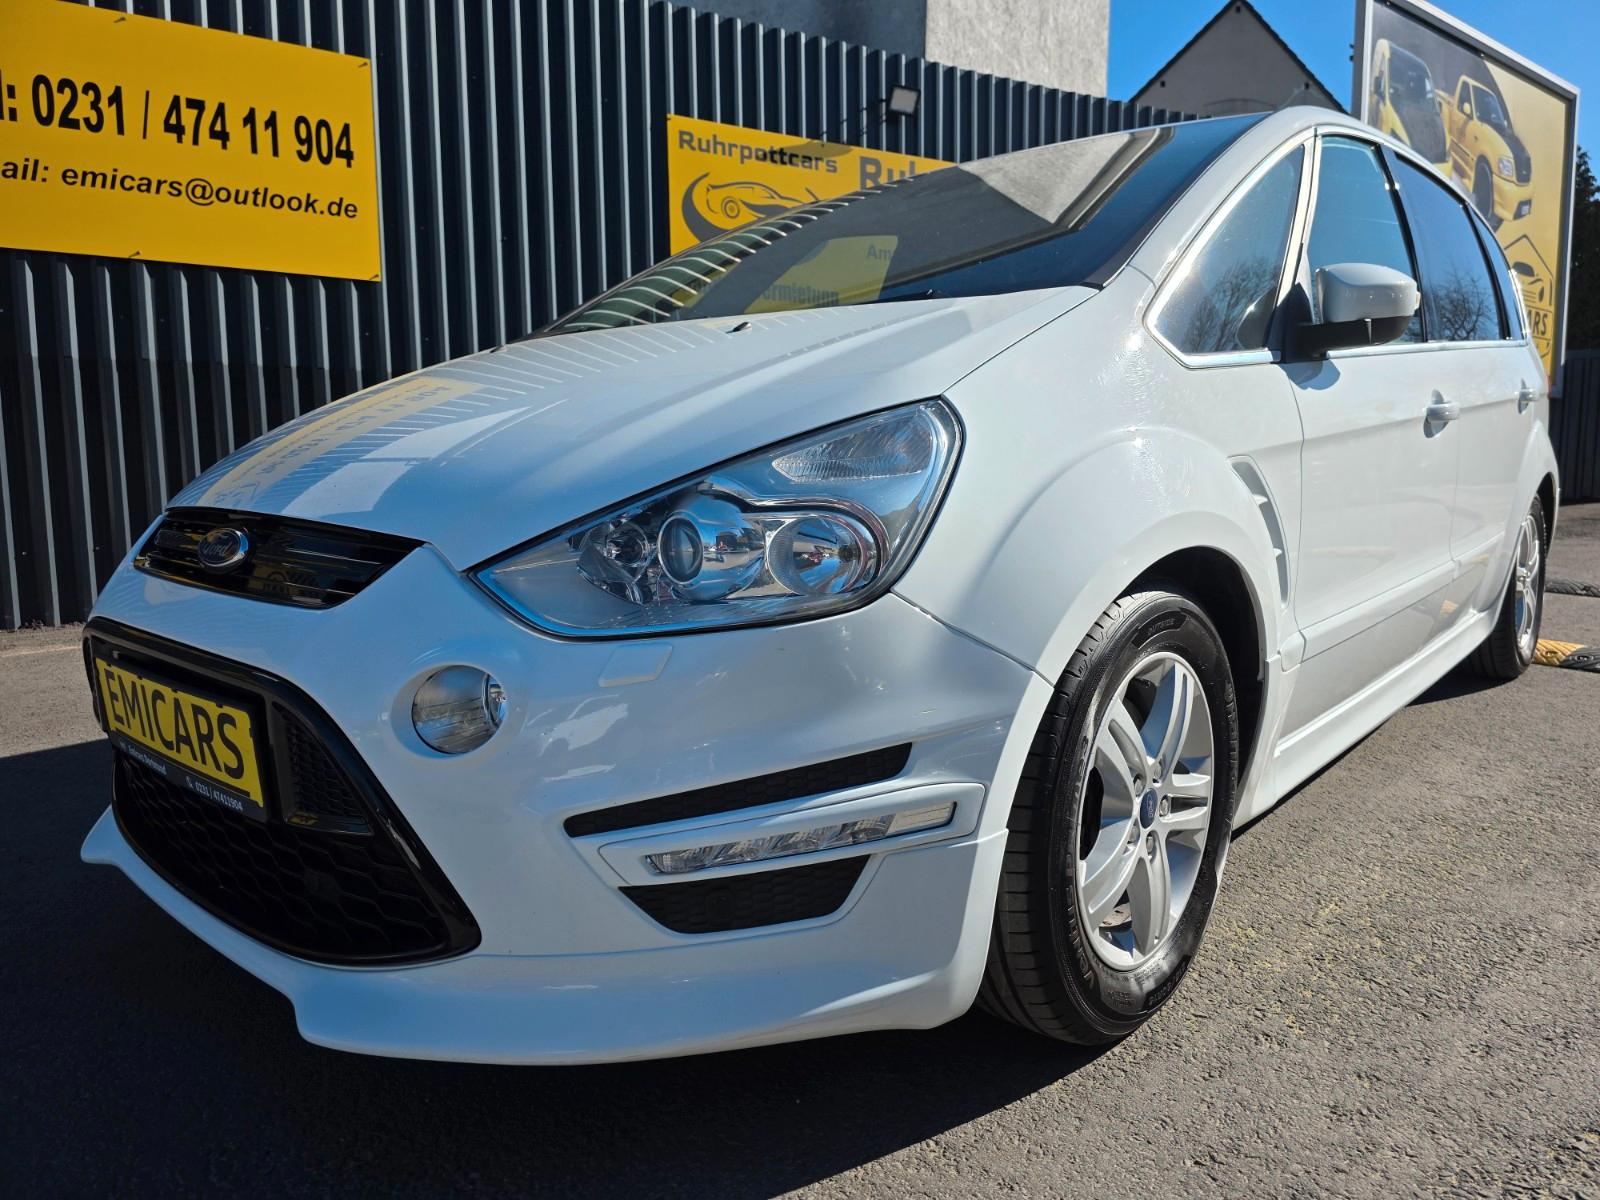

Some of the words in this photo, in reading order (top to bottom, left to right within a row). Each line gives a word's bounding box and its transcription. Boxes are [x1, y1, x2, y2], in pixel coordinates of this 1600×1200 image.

[32, 74, 125, 136] 0231
[163, 94, 230, 151] 474
[242, 106, 280, 158] 11
[294, 115, 354, 168] 904
[678, 129, 838, 174] Ruhrpottcars
[0, 158, 50, 183] ail:
[61, 167, 358, 219] emicars@outlook.de
[103, 667, 245, 780] EMICARS
